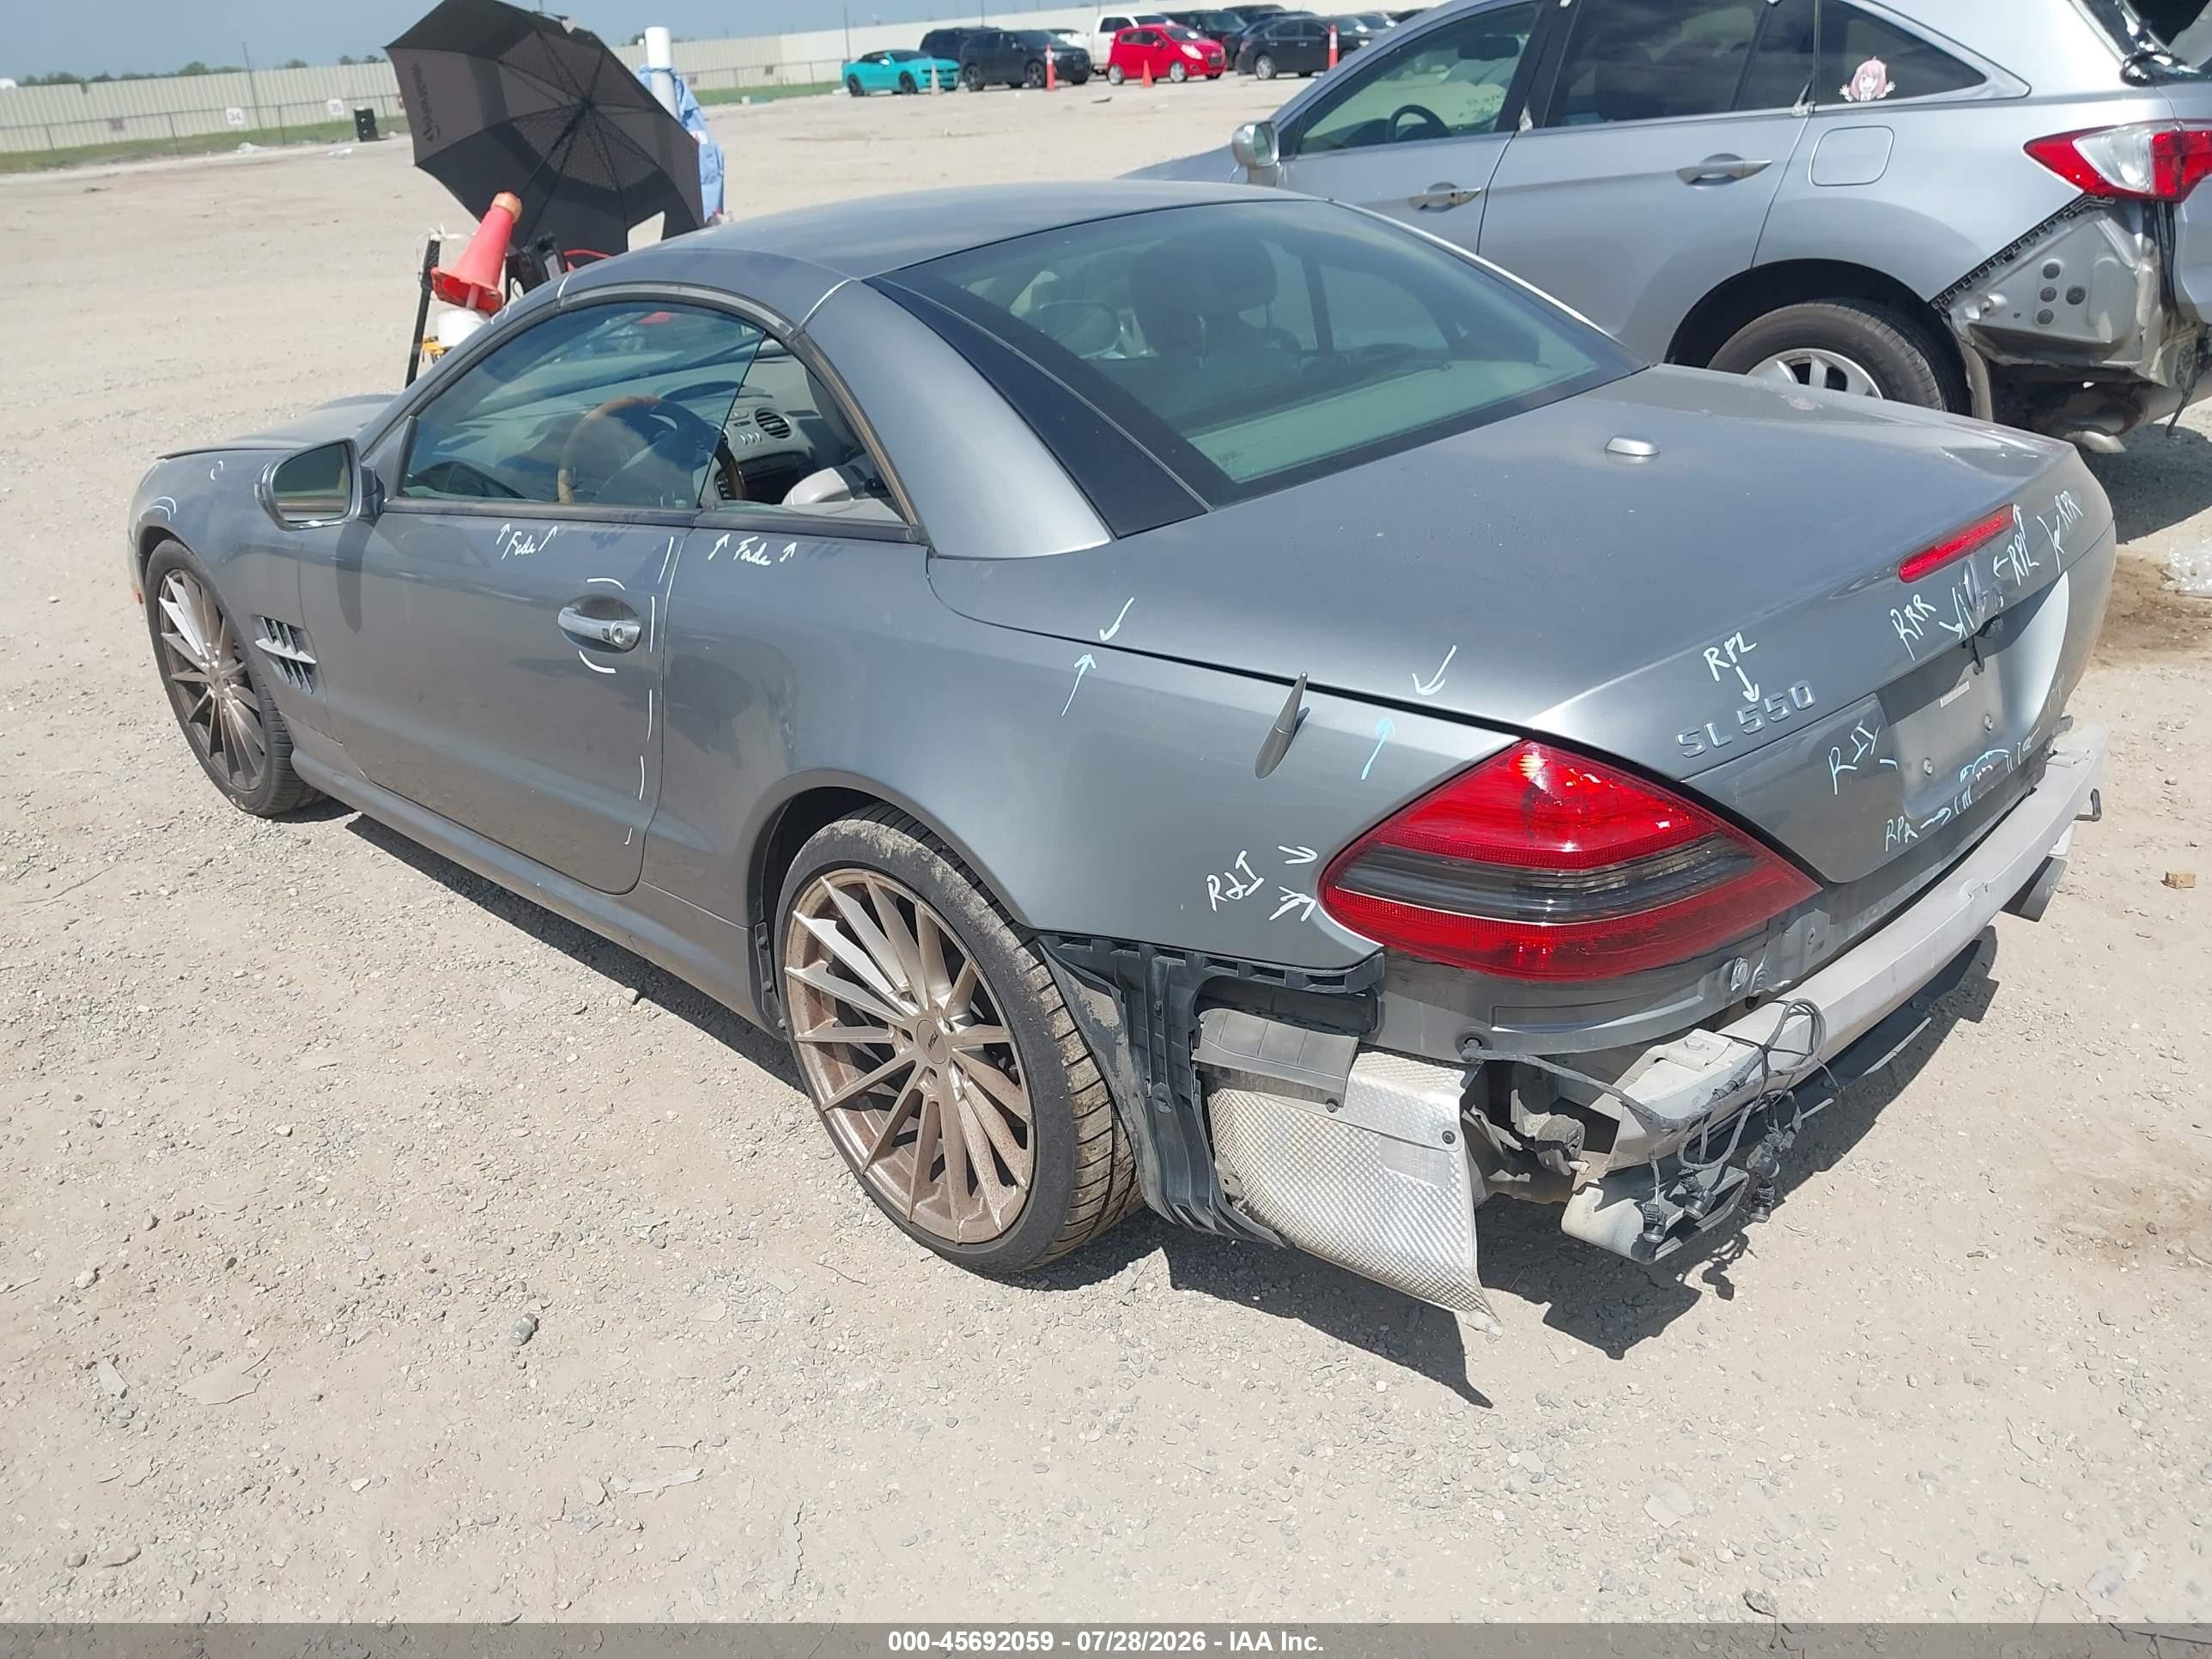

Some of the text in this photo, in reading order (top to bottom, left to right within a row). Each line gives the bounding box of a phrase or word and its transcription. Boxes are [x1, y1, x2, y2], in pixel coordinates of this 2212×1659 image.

[733, 536, 771, 566] Fade
[1703, 631, 1758, 682] RPL
[1676, 681, 1815, 758] SL 550
